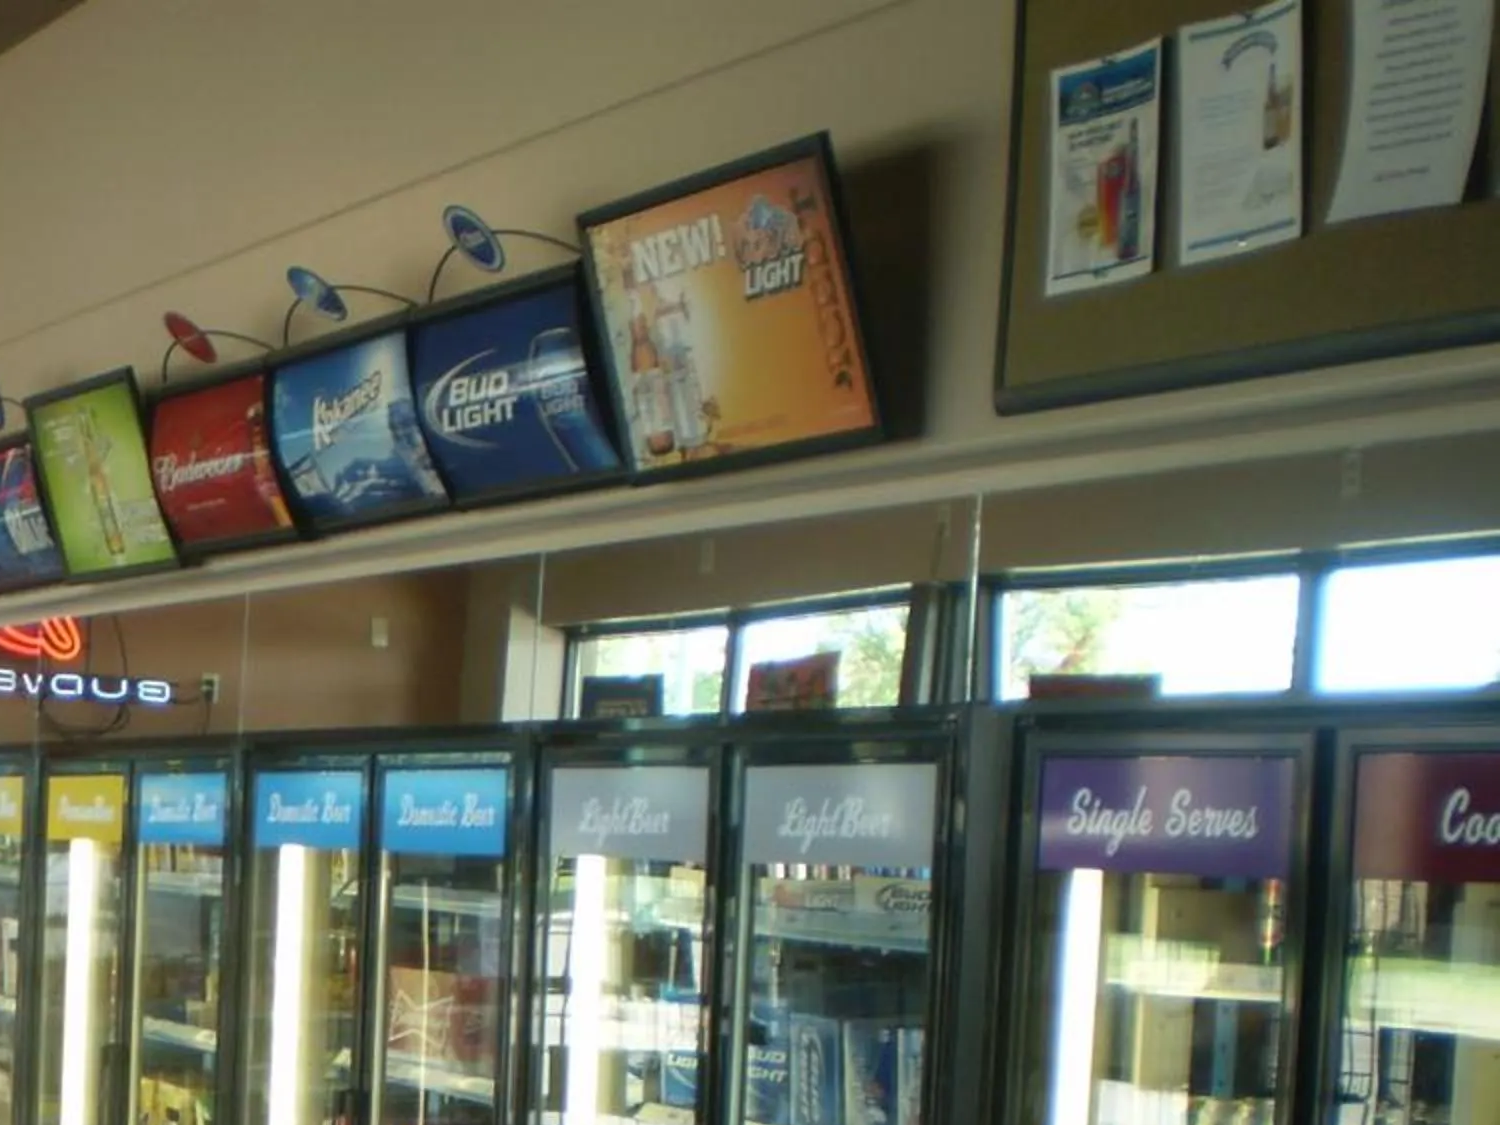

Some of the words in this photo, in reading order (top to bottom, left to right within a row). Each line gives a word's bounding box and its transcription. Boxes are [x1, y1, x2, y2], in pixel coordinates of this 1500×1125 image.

[630, 213, 726, 283] NEW!
[743, 253, 804, 298] LIGHT
[448, 371, 509, 406] BUD
[441, 396, 518, 433] LIGHT
[152, 450, 244, 494] Budweiser
[578, 798, 631, 847] Light
[628, 797, 670, 834] Beer
[777, 796, 840, 854] Light
[839, 797, 893, 839] Beer
[1066, 786, 1153, 857] Single
[1164, 787, 1260, 839] Serves
